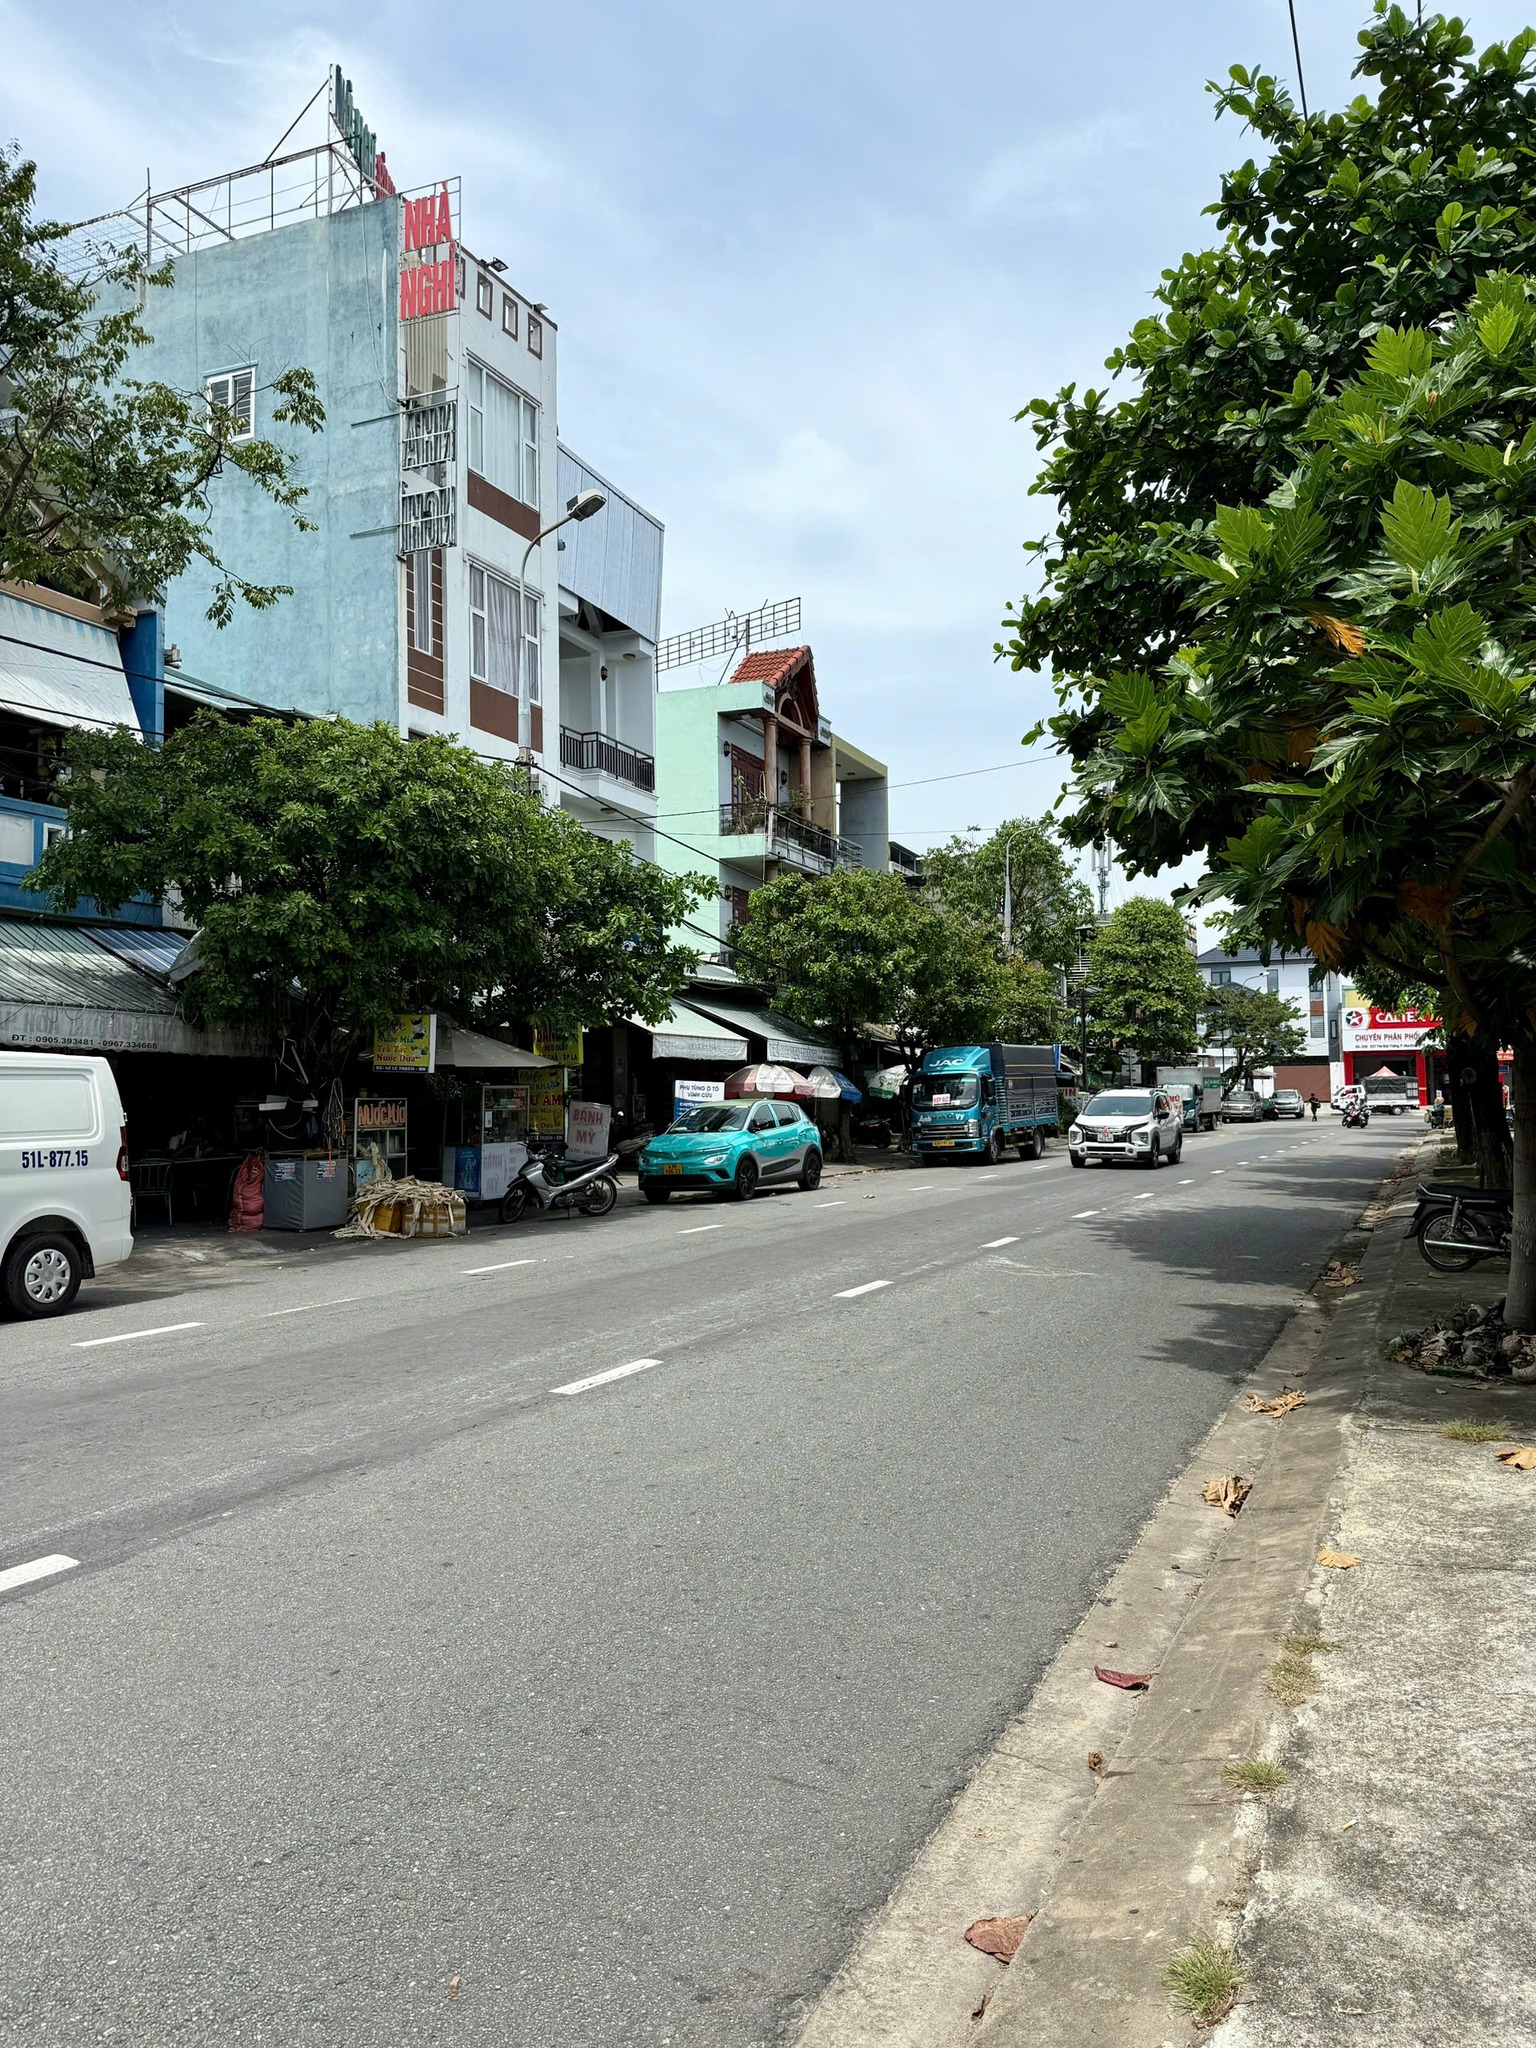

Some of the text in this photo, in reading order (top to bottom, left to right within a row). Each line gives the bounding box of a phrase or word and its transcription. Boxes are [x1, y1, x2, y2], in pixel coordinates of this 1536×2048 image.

[404, 181, 452, 251] NHÀ
[401, 240, 456, 321] NGHỈ
[35, 1036, 94, 1046] 0905.393481
[102, 1040, 158, 1050] 0967.334668
[1354, 1032, 1382, 1042] CHUYÊN
[1384, 1031, 1402, 1041] PHÂN
[929, 1058, 965, 1067] JAC
[21, 1150, 89, 1169] 51L-877.15
